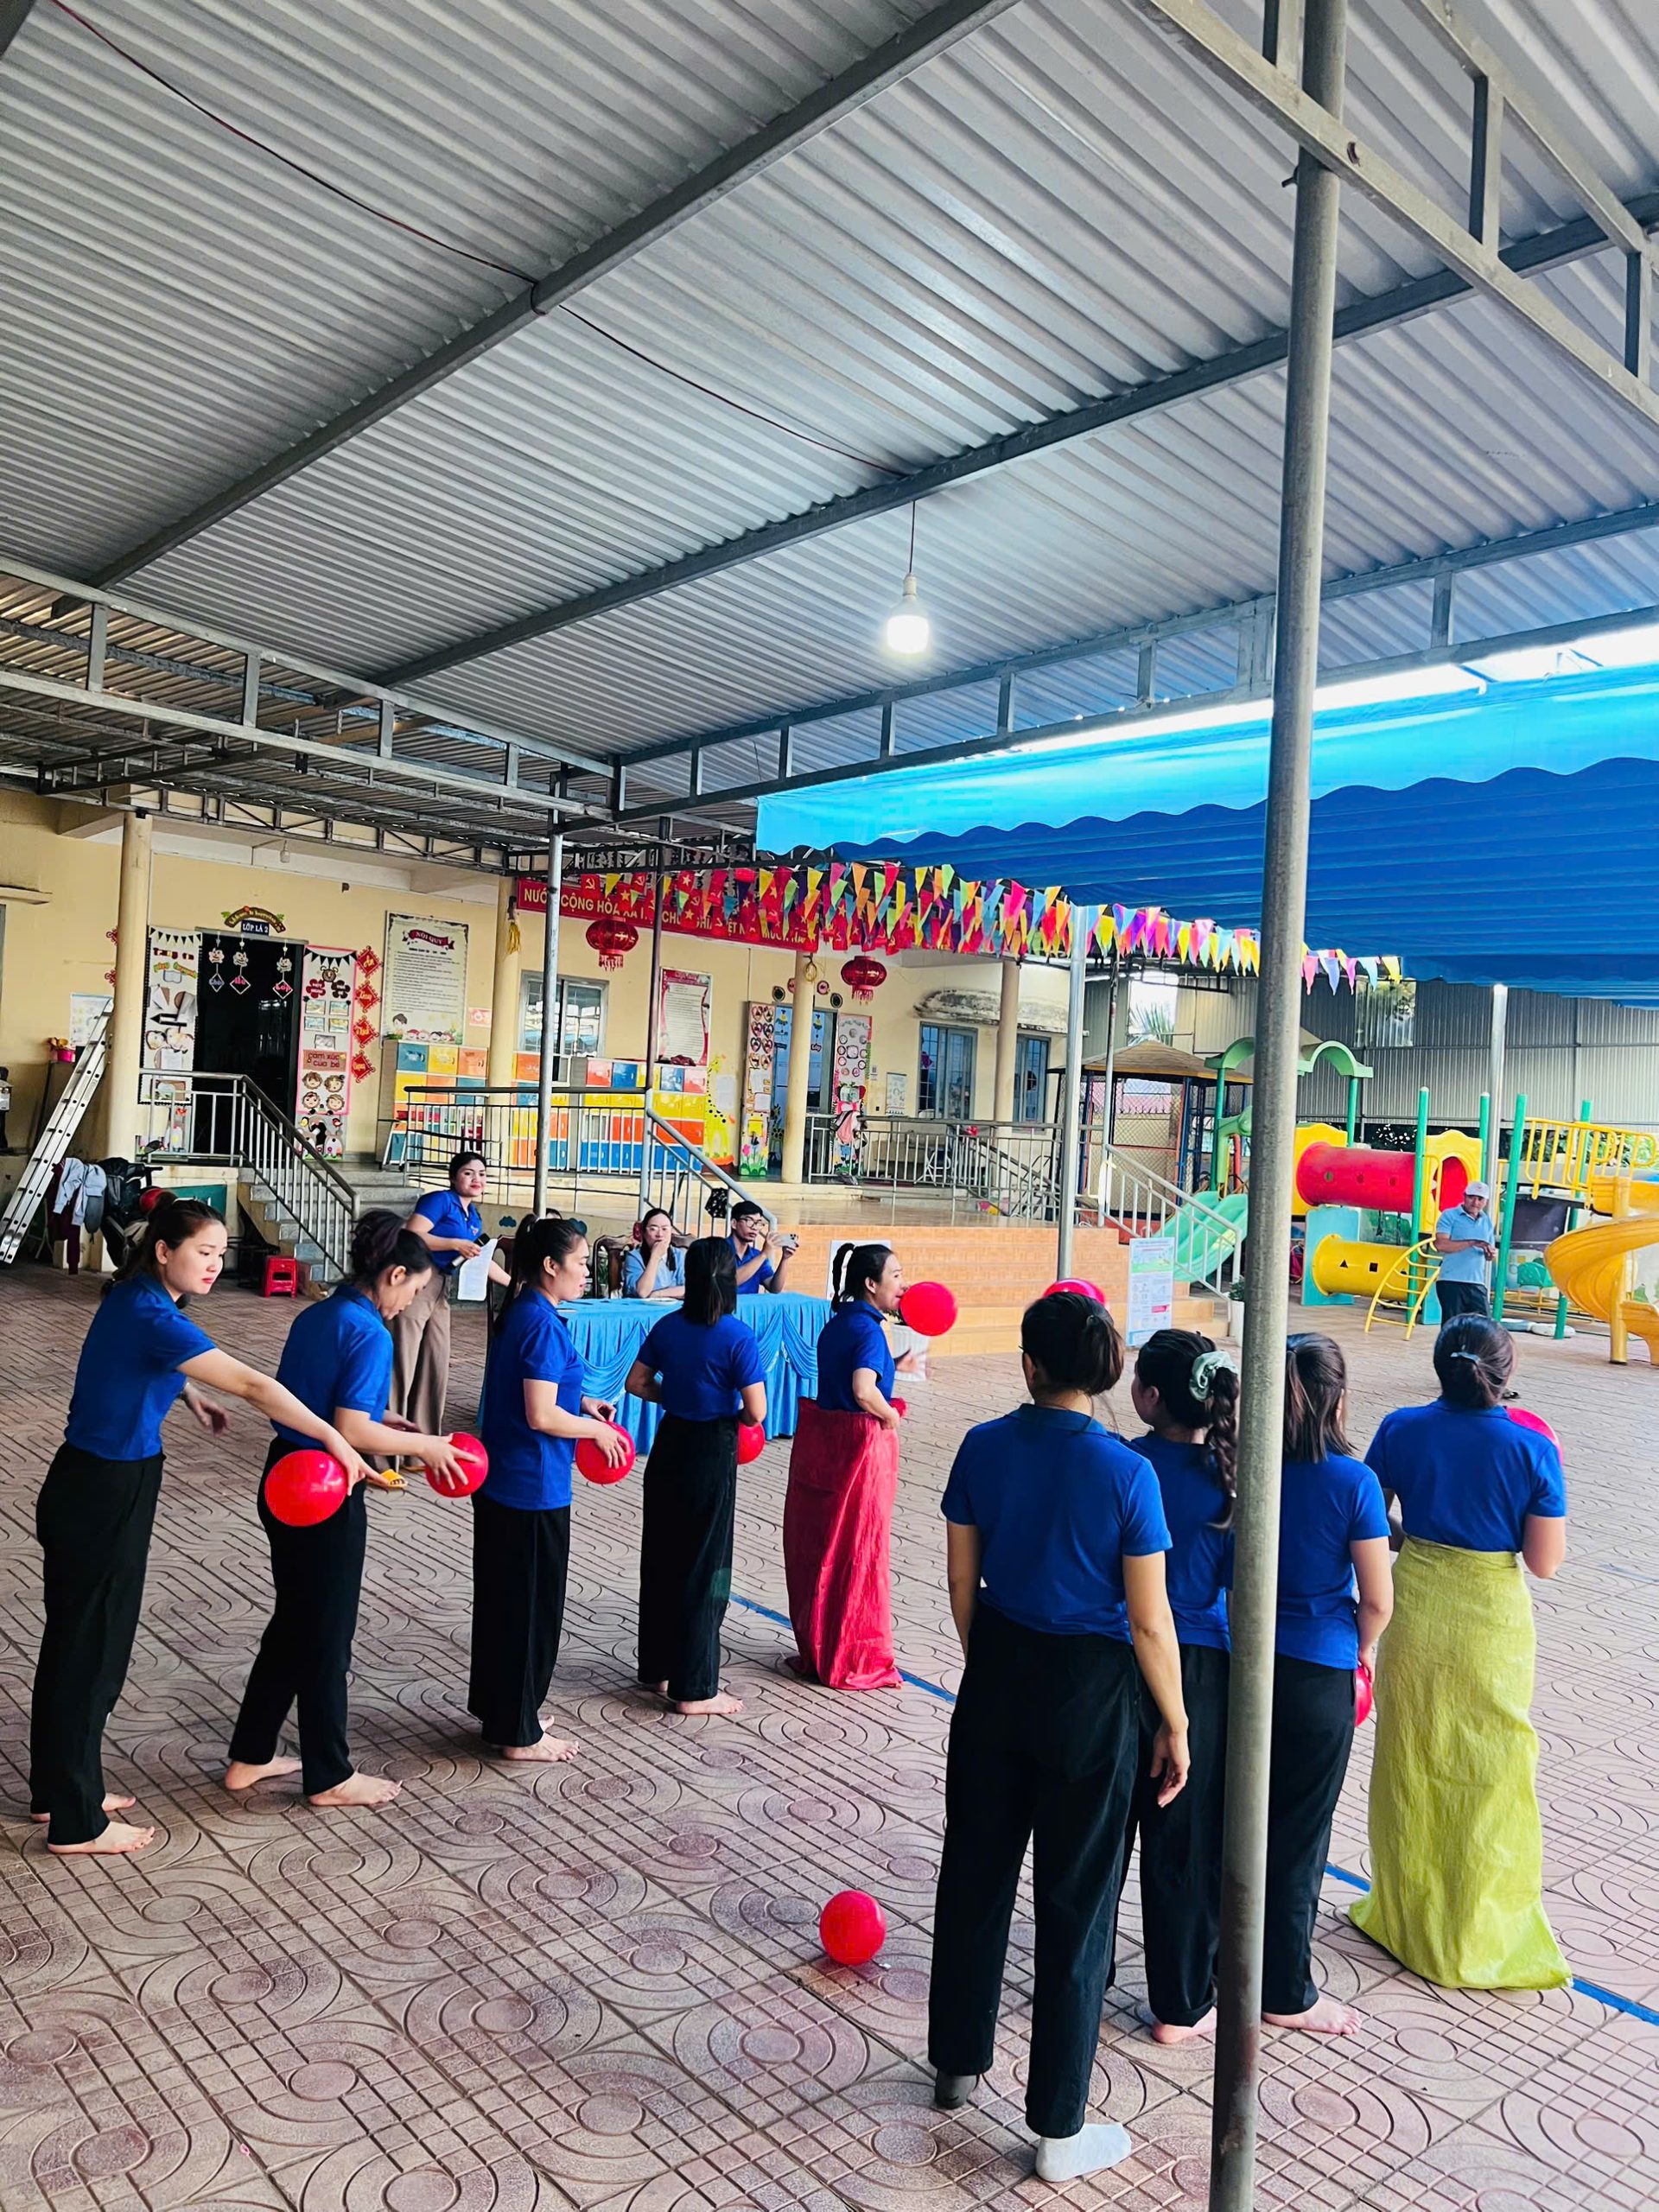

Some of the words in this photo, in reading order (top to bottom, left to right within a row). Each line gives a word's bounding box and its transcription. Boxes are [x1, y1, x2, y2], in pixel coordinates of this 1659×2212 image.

[524, 887, 548, 905] NƯỚ
[560, 892, 594, 912] CỘNG
[596, 897, 620, 916] HÒA
